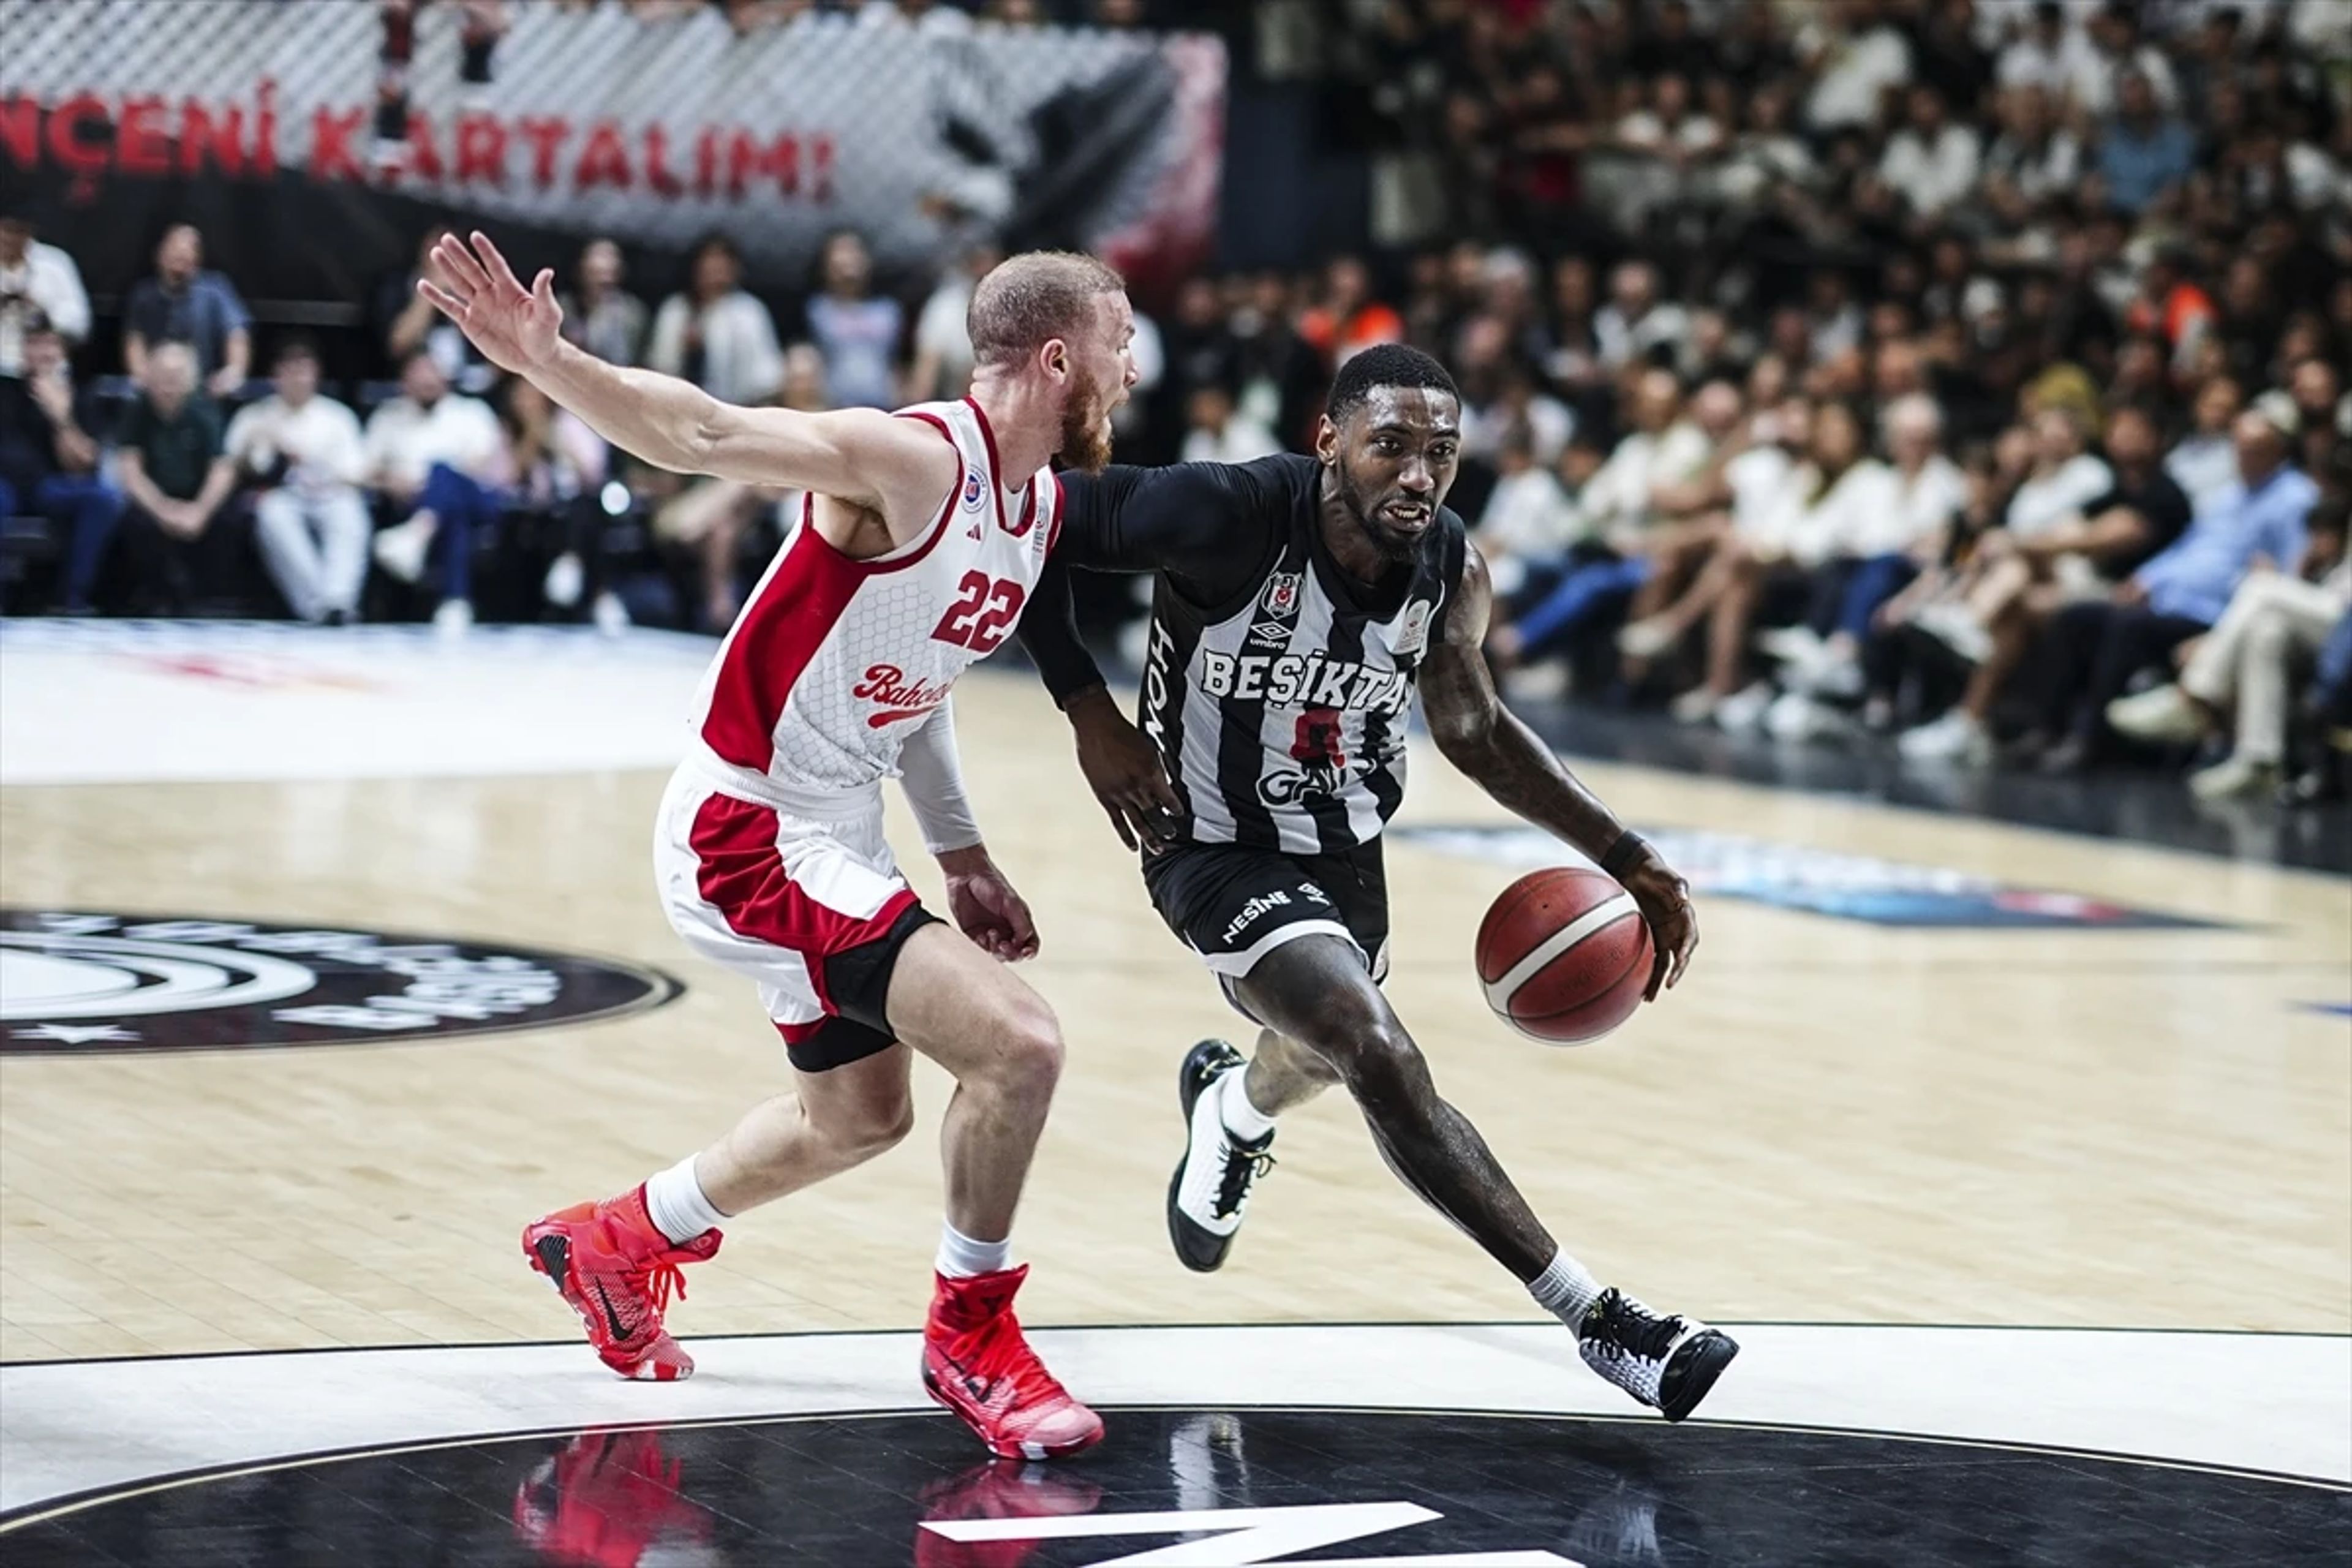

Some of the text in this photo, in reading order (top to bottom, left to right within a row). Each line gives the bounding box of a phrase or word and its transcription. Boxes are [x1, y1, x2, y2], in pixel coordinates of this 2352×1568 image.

[930, 569, 1026, 654] 22
[1145, 616, 1175, 816] HON
[1201, 647, 1412, 715] BEŞİKTA
